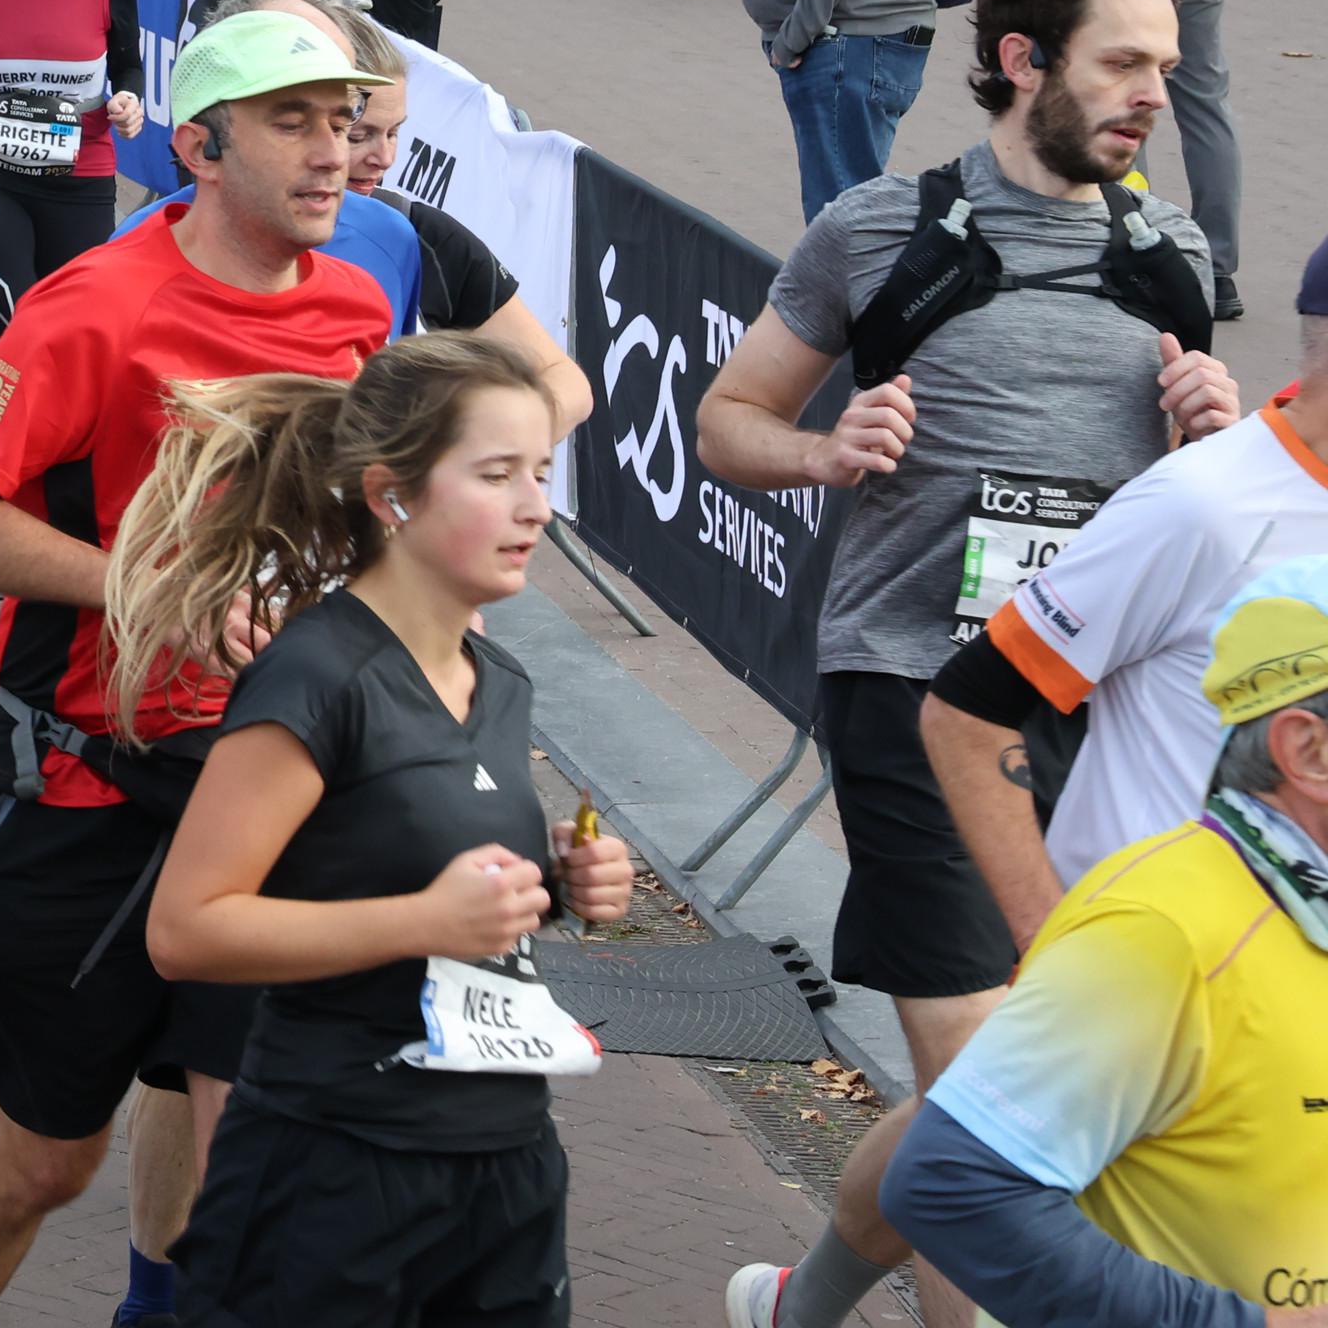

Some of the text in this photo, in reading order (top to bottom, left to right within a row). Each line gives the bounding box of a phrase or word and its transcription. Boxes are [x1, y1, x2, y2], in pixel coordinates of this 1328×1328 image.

[56, 114, 77, 122] TATA
[1, 143, 50, 161] 17967
[901, 265, 961, 322] SALOMON
[981, 480, 1033, 515] tcs
[1038, 487, 1068, 498] TATA
[1035, 508, 1079, 521] SERVICES
[698, 480, 787, 599] SERVICES
[463, 985, 521, 1029] NELE
